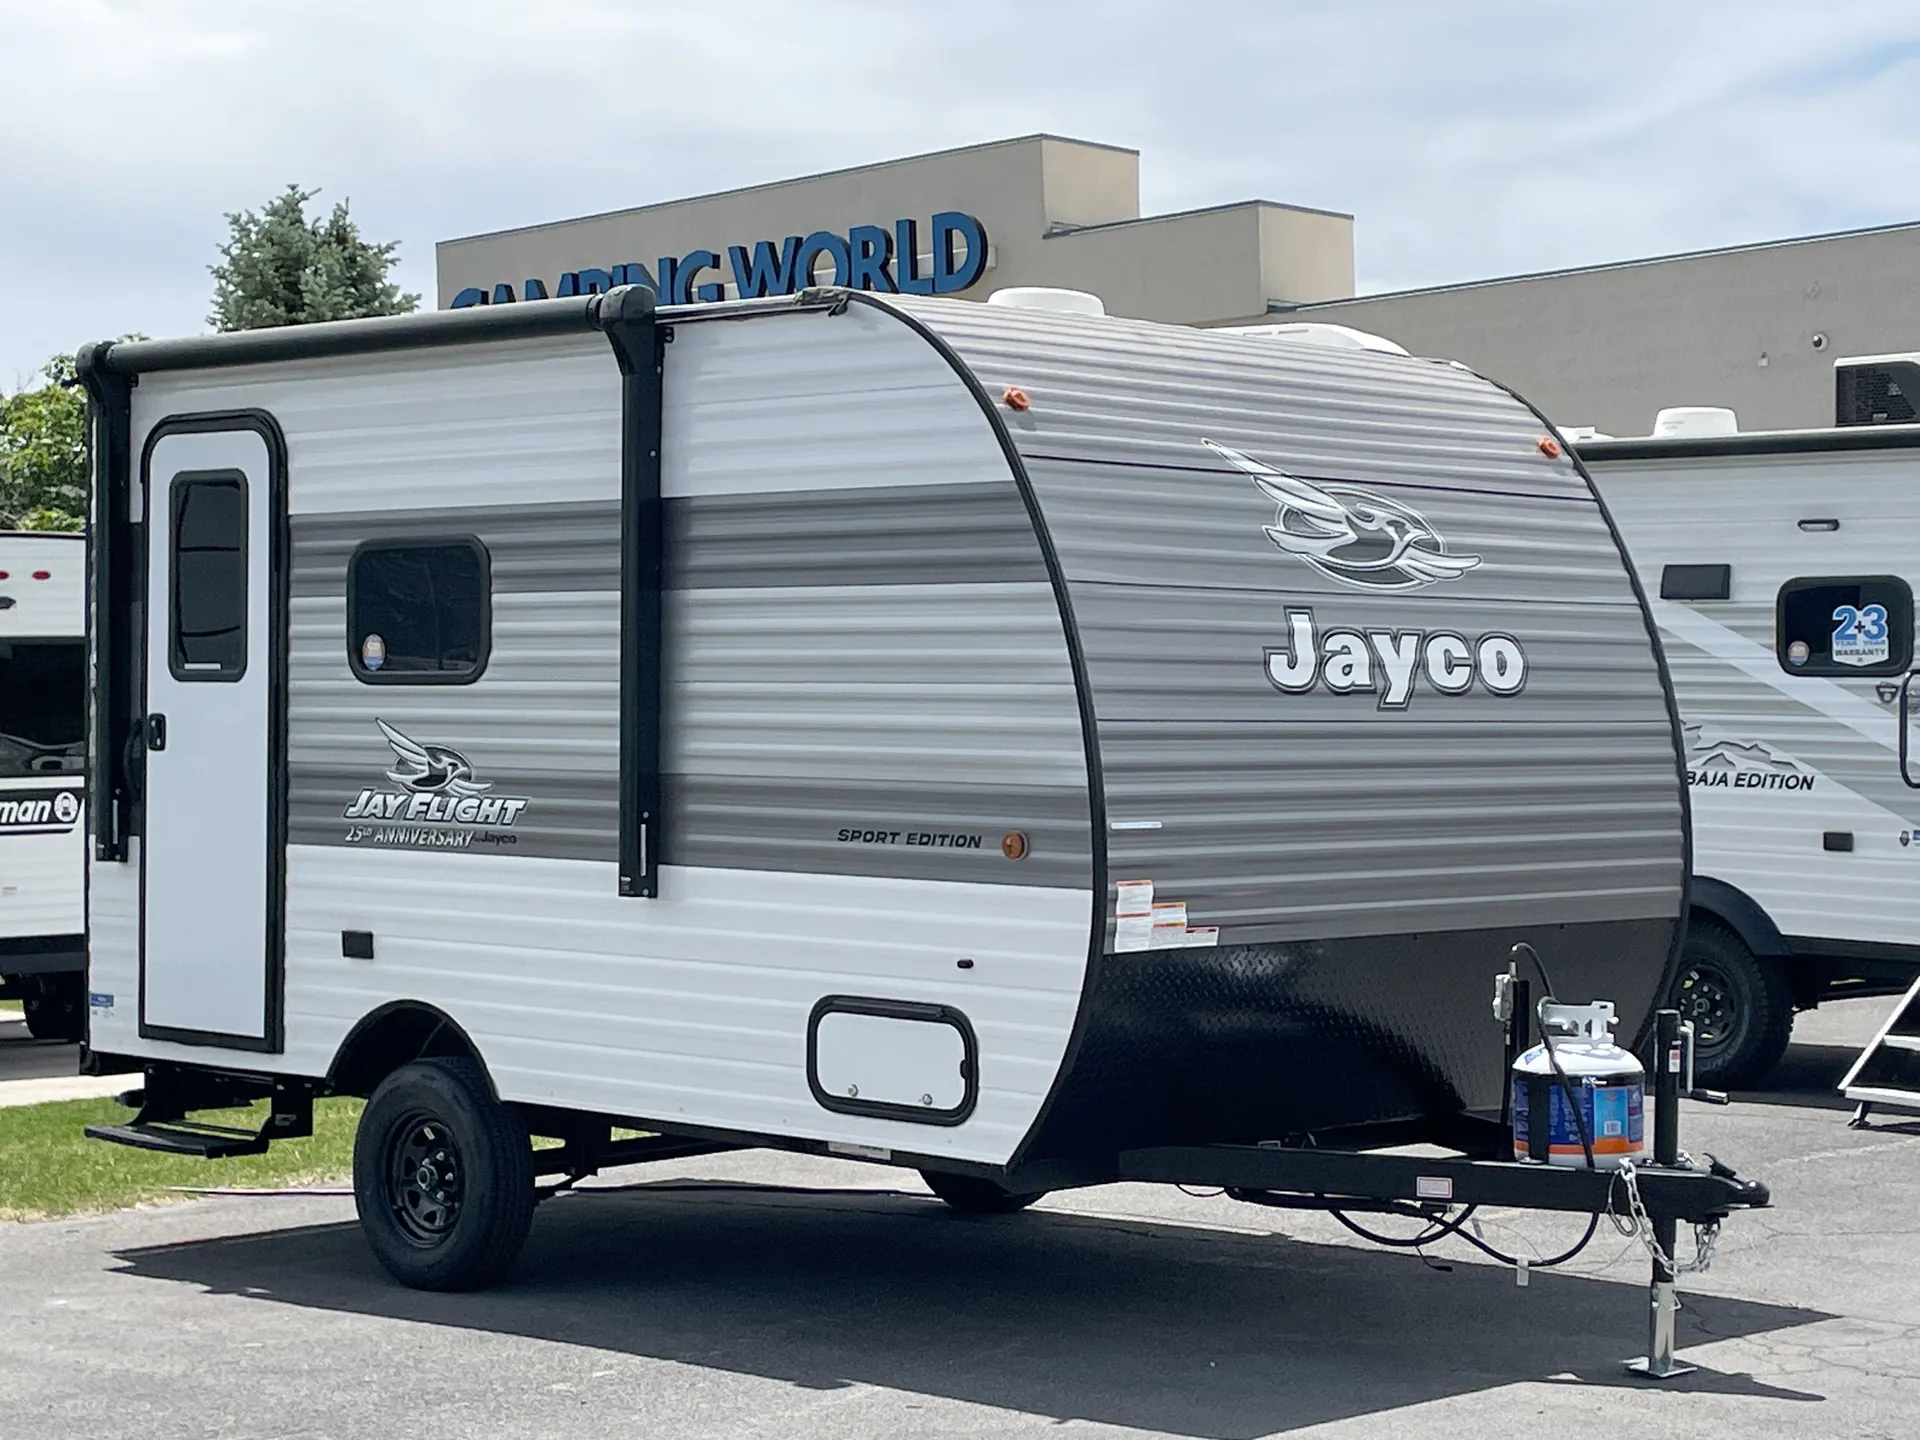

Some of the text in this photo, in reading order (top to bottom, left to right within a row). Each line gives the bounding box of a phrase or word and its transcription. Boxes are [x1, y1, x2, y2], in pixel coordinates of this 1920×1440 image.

[728, 211, 988, 302] WORLD
[1263, 605, 1529, 711] Jayco
[1835, 648, 1886, 656] WARRANTY
[1687, 771, 1815, 791] BAJA EDITION
[345, 788, 528, 824] JAY FLIGHT
[373, 826, 475, 847] ANNIVERSARY
[837, 828, 982, 849] SPORT EDITION
